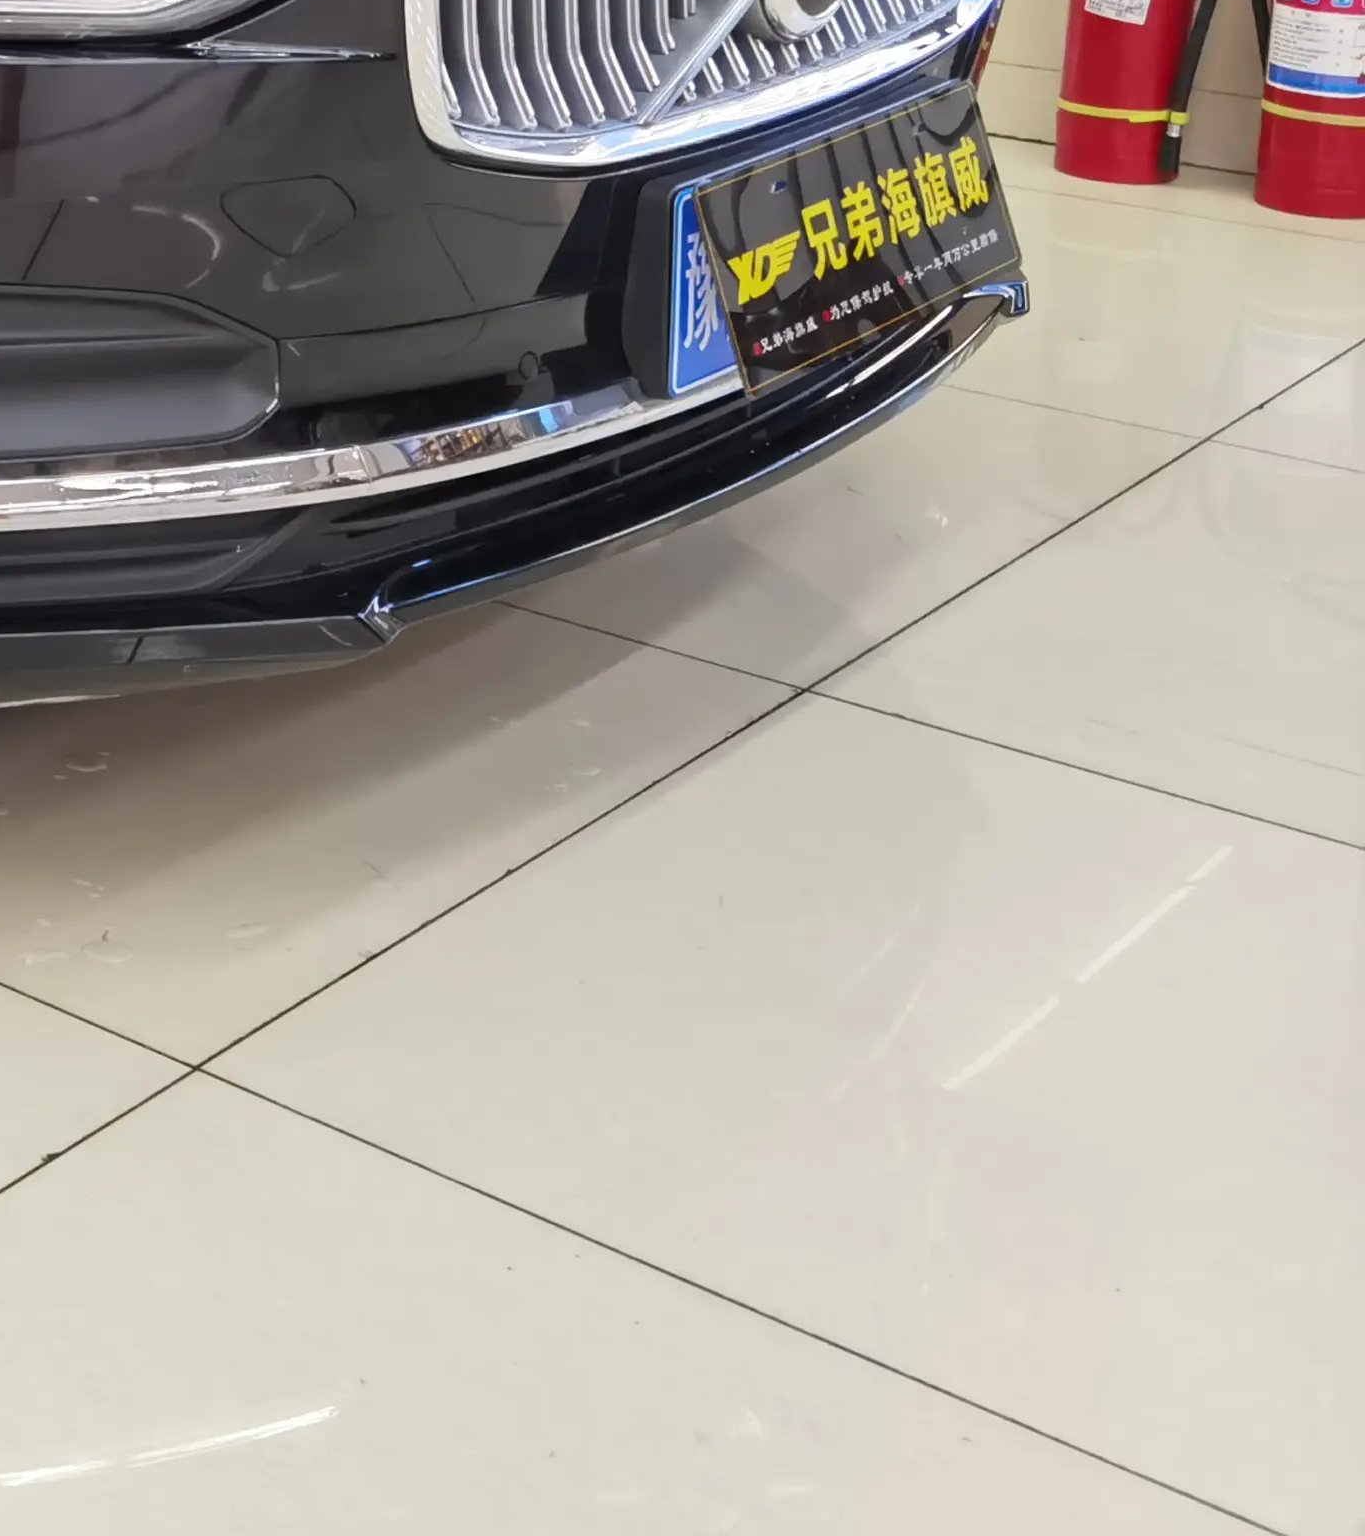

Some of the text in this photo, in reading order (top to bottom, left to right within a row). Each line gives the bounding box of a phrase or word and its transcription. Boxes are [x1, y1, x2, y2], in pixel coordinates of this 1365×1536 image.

[801, 136, 990, 281] 兄弟海旗威
